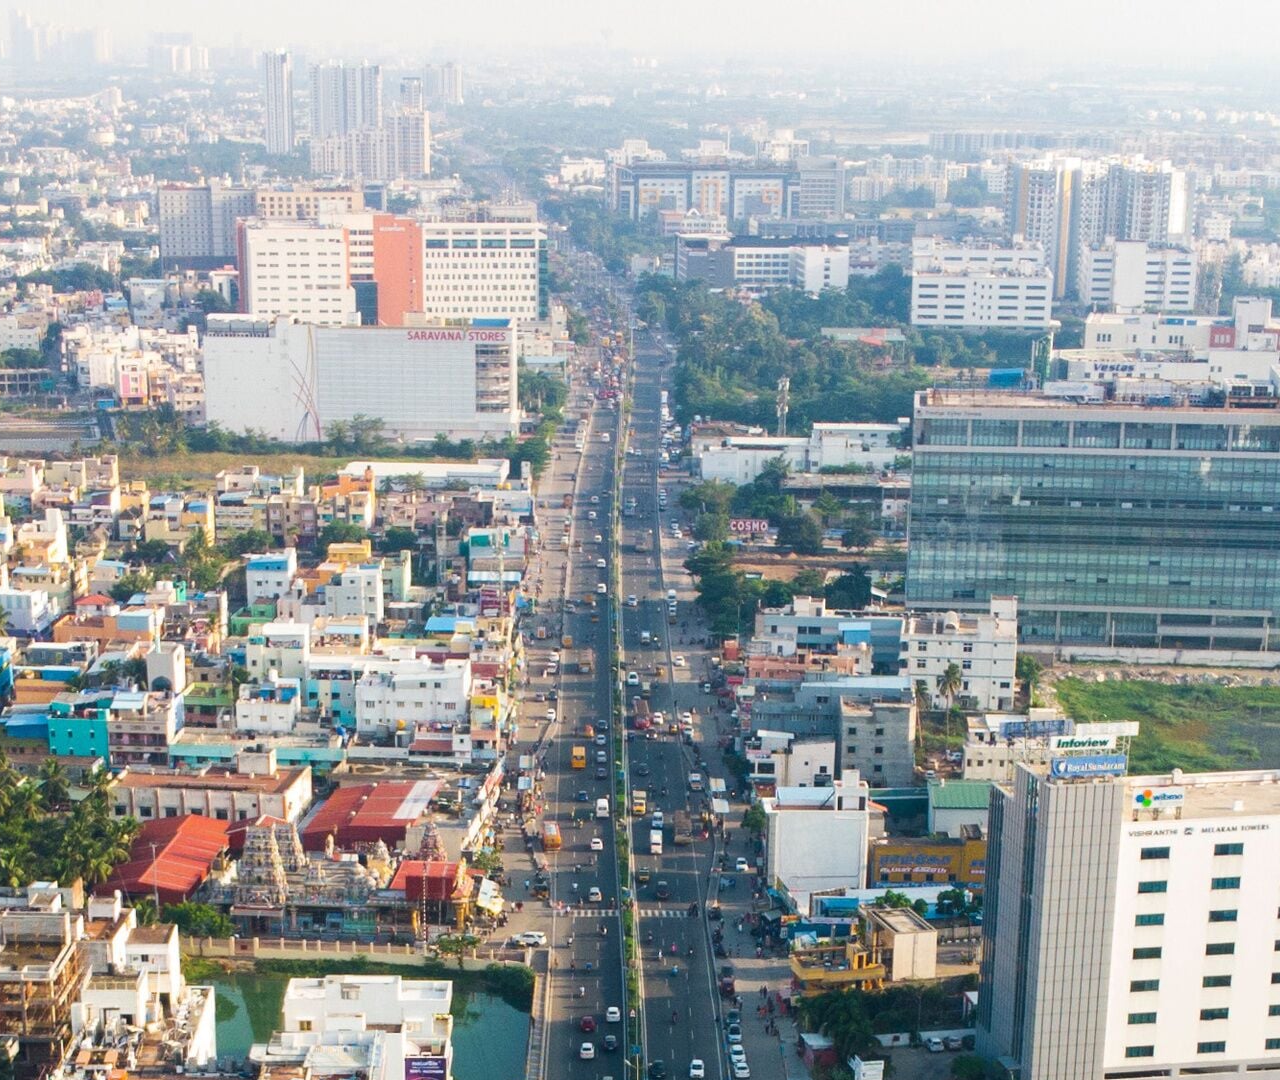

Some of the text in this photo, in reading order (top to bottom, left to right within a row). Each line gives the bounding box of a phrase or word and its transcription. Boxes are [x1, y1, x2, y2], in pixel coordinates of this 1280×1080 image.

[408, 331, 506, 341] SARAVANA STORES
[1094, 363, 1136, 372] Vestas
[730, 521, 768, 531] COSMO
[1056, 737, 1109, 748] Infoview
